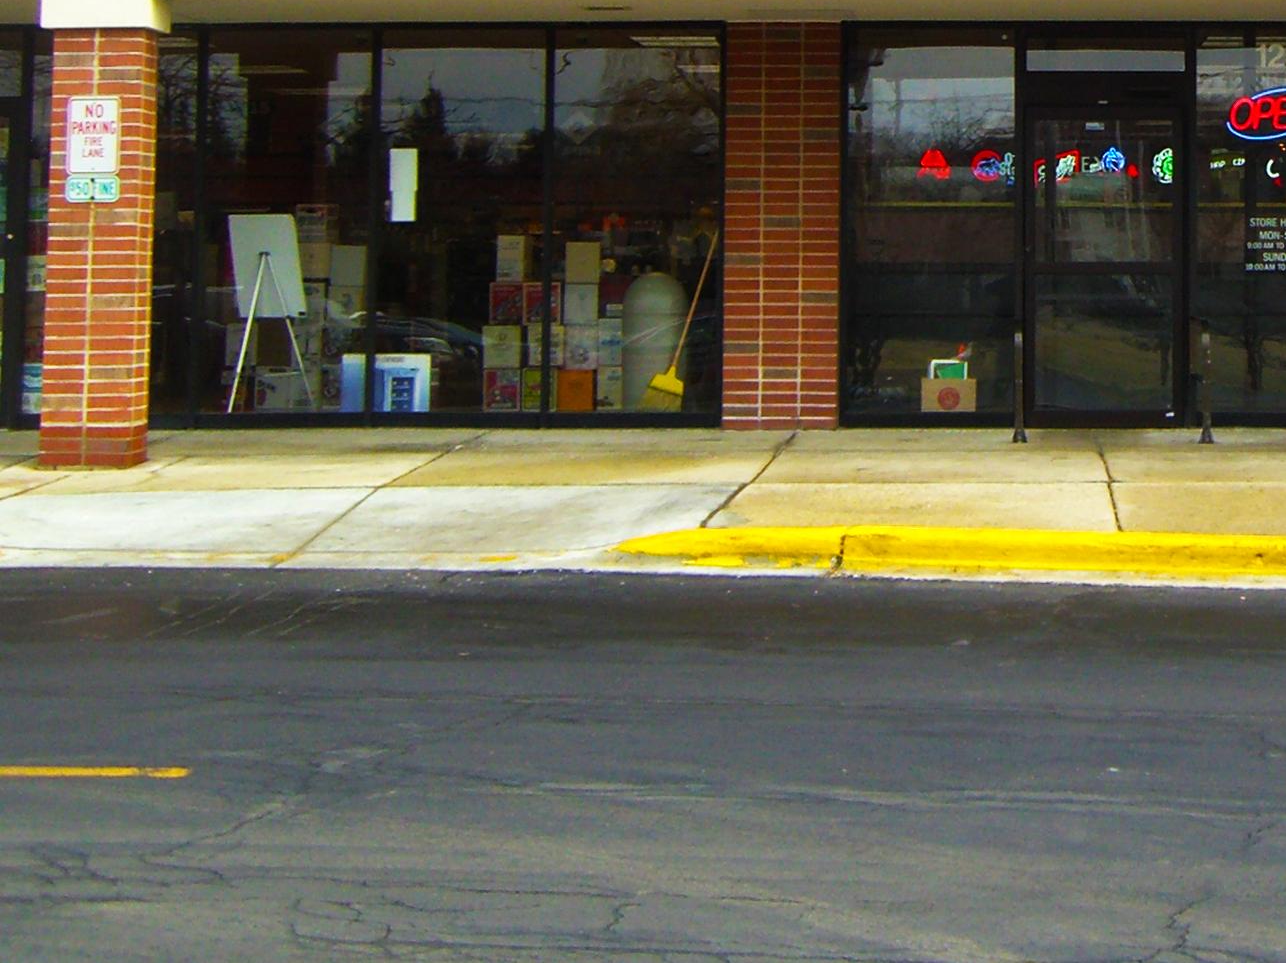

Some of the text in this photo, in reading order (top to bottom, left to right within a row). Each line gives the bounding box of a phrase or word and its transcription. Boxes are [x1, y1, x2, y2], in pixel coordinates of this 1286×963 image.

[85, 104, 104, 118] NO
[72, 121, 116, 135] PARKING
[84, 137, 103, 146] FIRE
[82, 148, 104, 157] LANE
[1249, 218, 1277, 228] STORE
